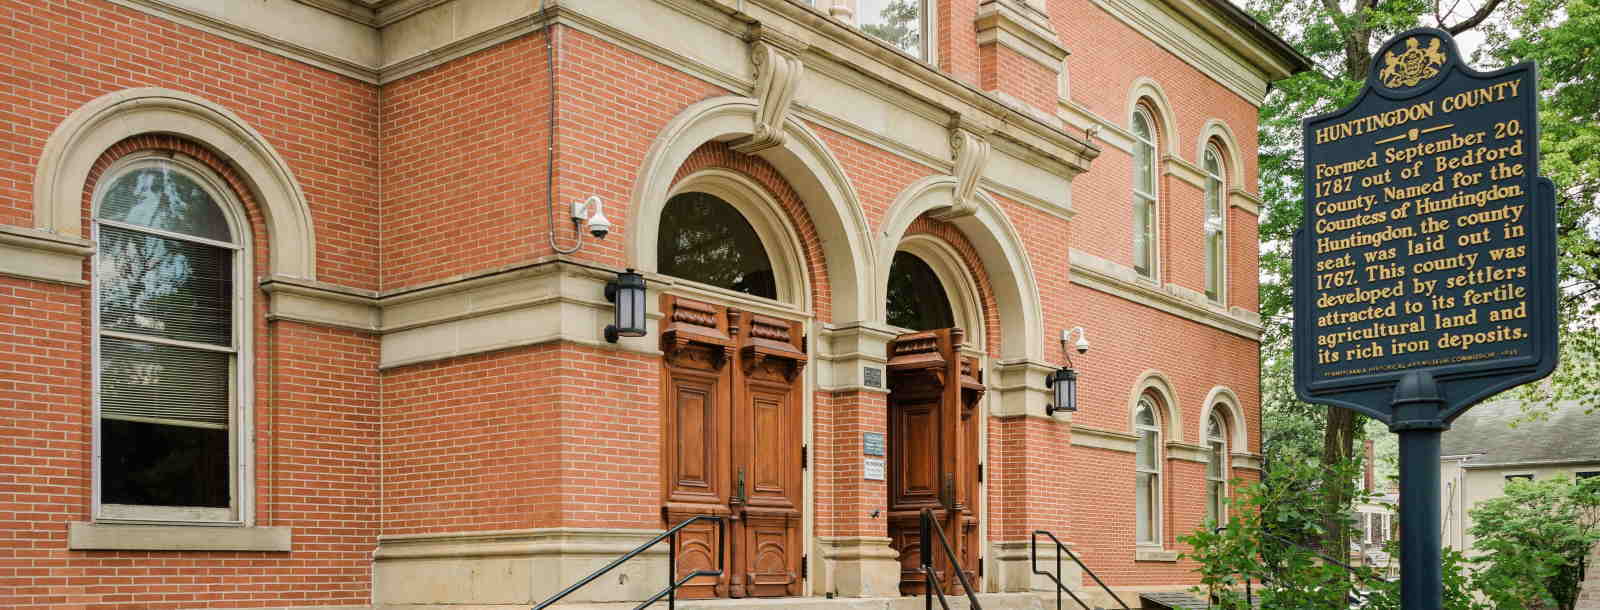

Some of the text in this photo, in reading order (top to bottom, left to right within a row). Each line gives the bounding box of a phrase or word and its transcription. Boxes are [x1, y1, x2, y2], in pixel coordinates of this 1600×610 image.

[1315, 80, 1521, 145] HUNTINGDON COUNTY
[1315, 152, 1377, 180] Formed
[1385, 130, 1486, 164] September
[1315, 141, 1523, 198] 1787 out of Bedford
[1315, 162, 1524, 216] County. Named for the
[1315, 183, 1524, 234] Countess of Huntingdon.
[1420, 217, 1449, 234] the
[1457, 204, 1525, 228] county
[1364, 248, 1397, 264] was
[1408, 235, 1445, 256] laid
[1458, 229, 1492, 247] out
[1503, 224, 1525, 239] in
[1316, 245, 1526, 290] 1767. This county was
[1316, 265, 1527, 308] developed by settlers
[1317, 283, 1527, 327] attracted to its fertile
[1317, 302, 1527, 348] agricultural land and
[1317, 326, 1528, 364] its rich iron deposits.
